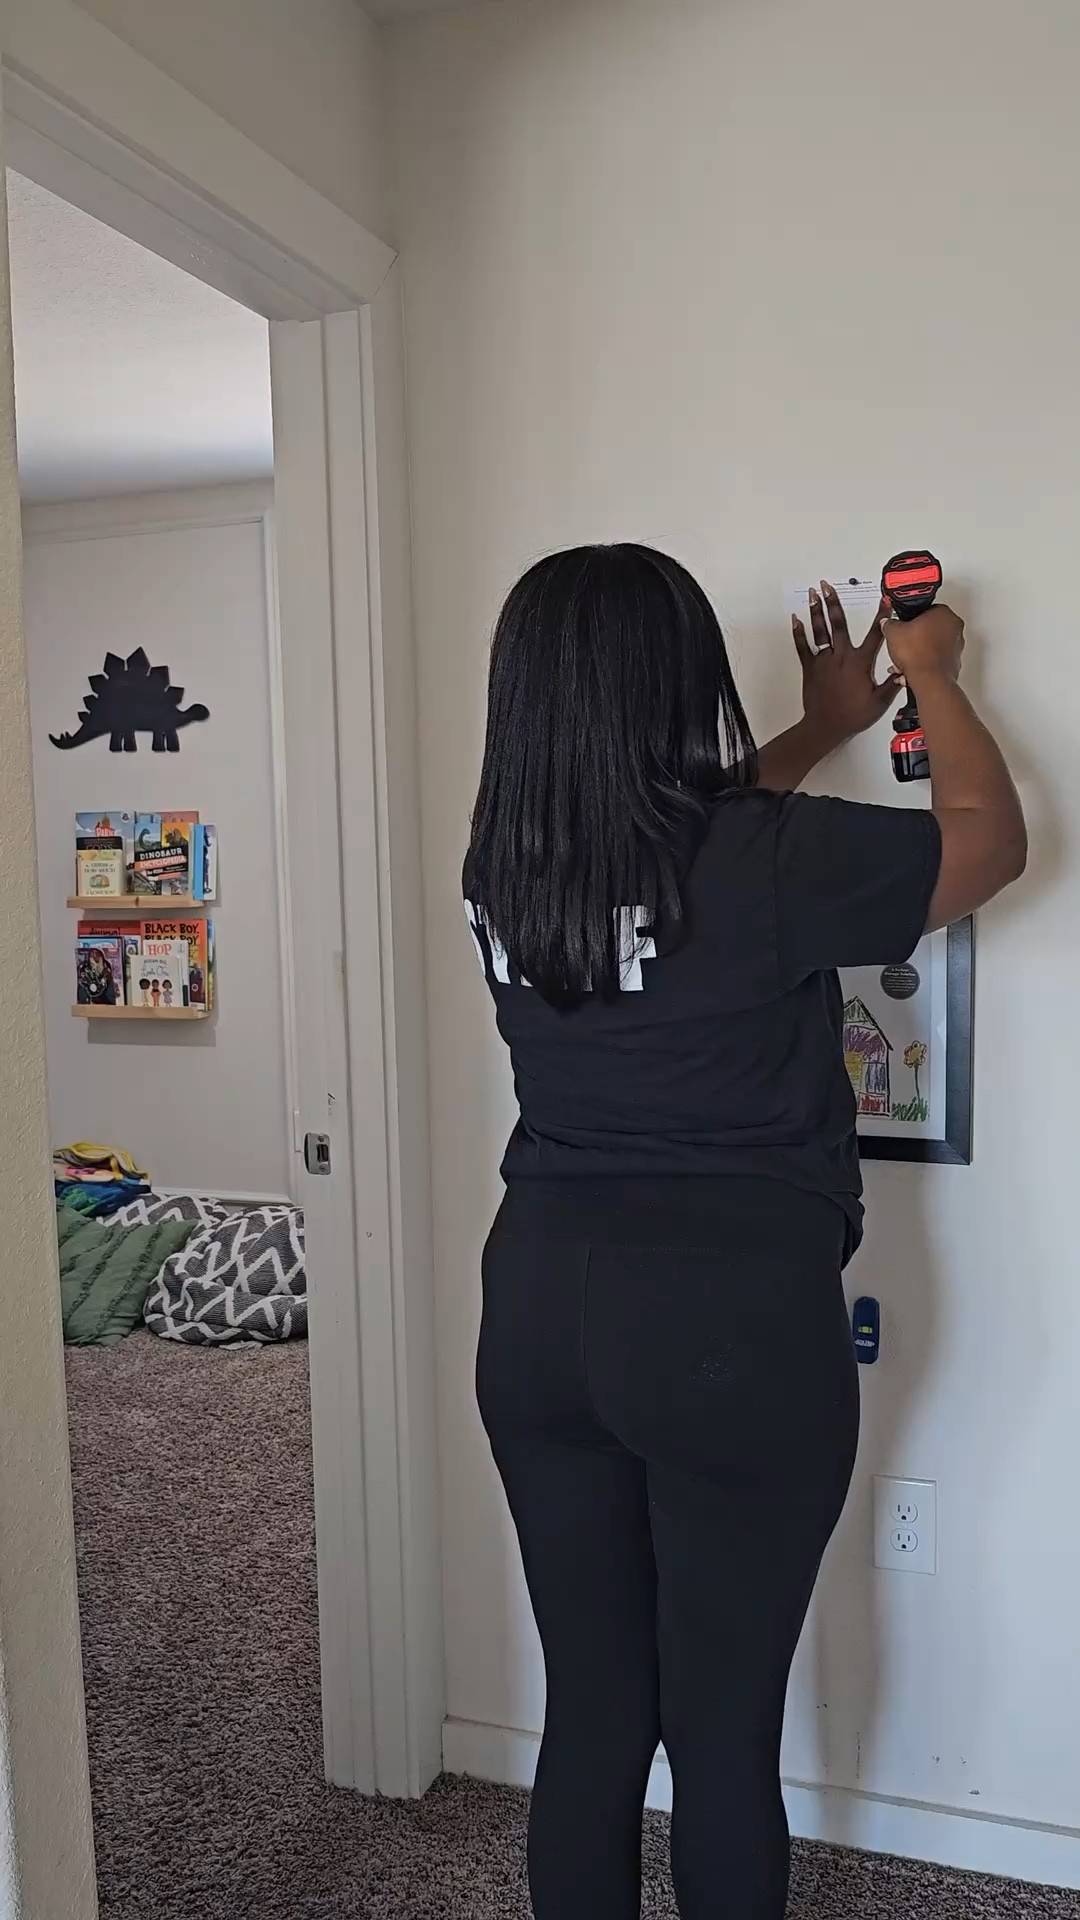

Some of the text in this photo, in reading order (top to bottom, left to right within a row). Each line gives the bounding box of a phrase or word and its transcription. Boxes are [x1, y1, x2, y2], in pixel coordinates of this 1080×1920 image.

[139, 847, 183, 860] DINOSAUR
[144, 923, 177, 934] BLACK
[147, 943, 172, 956] HOP
